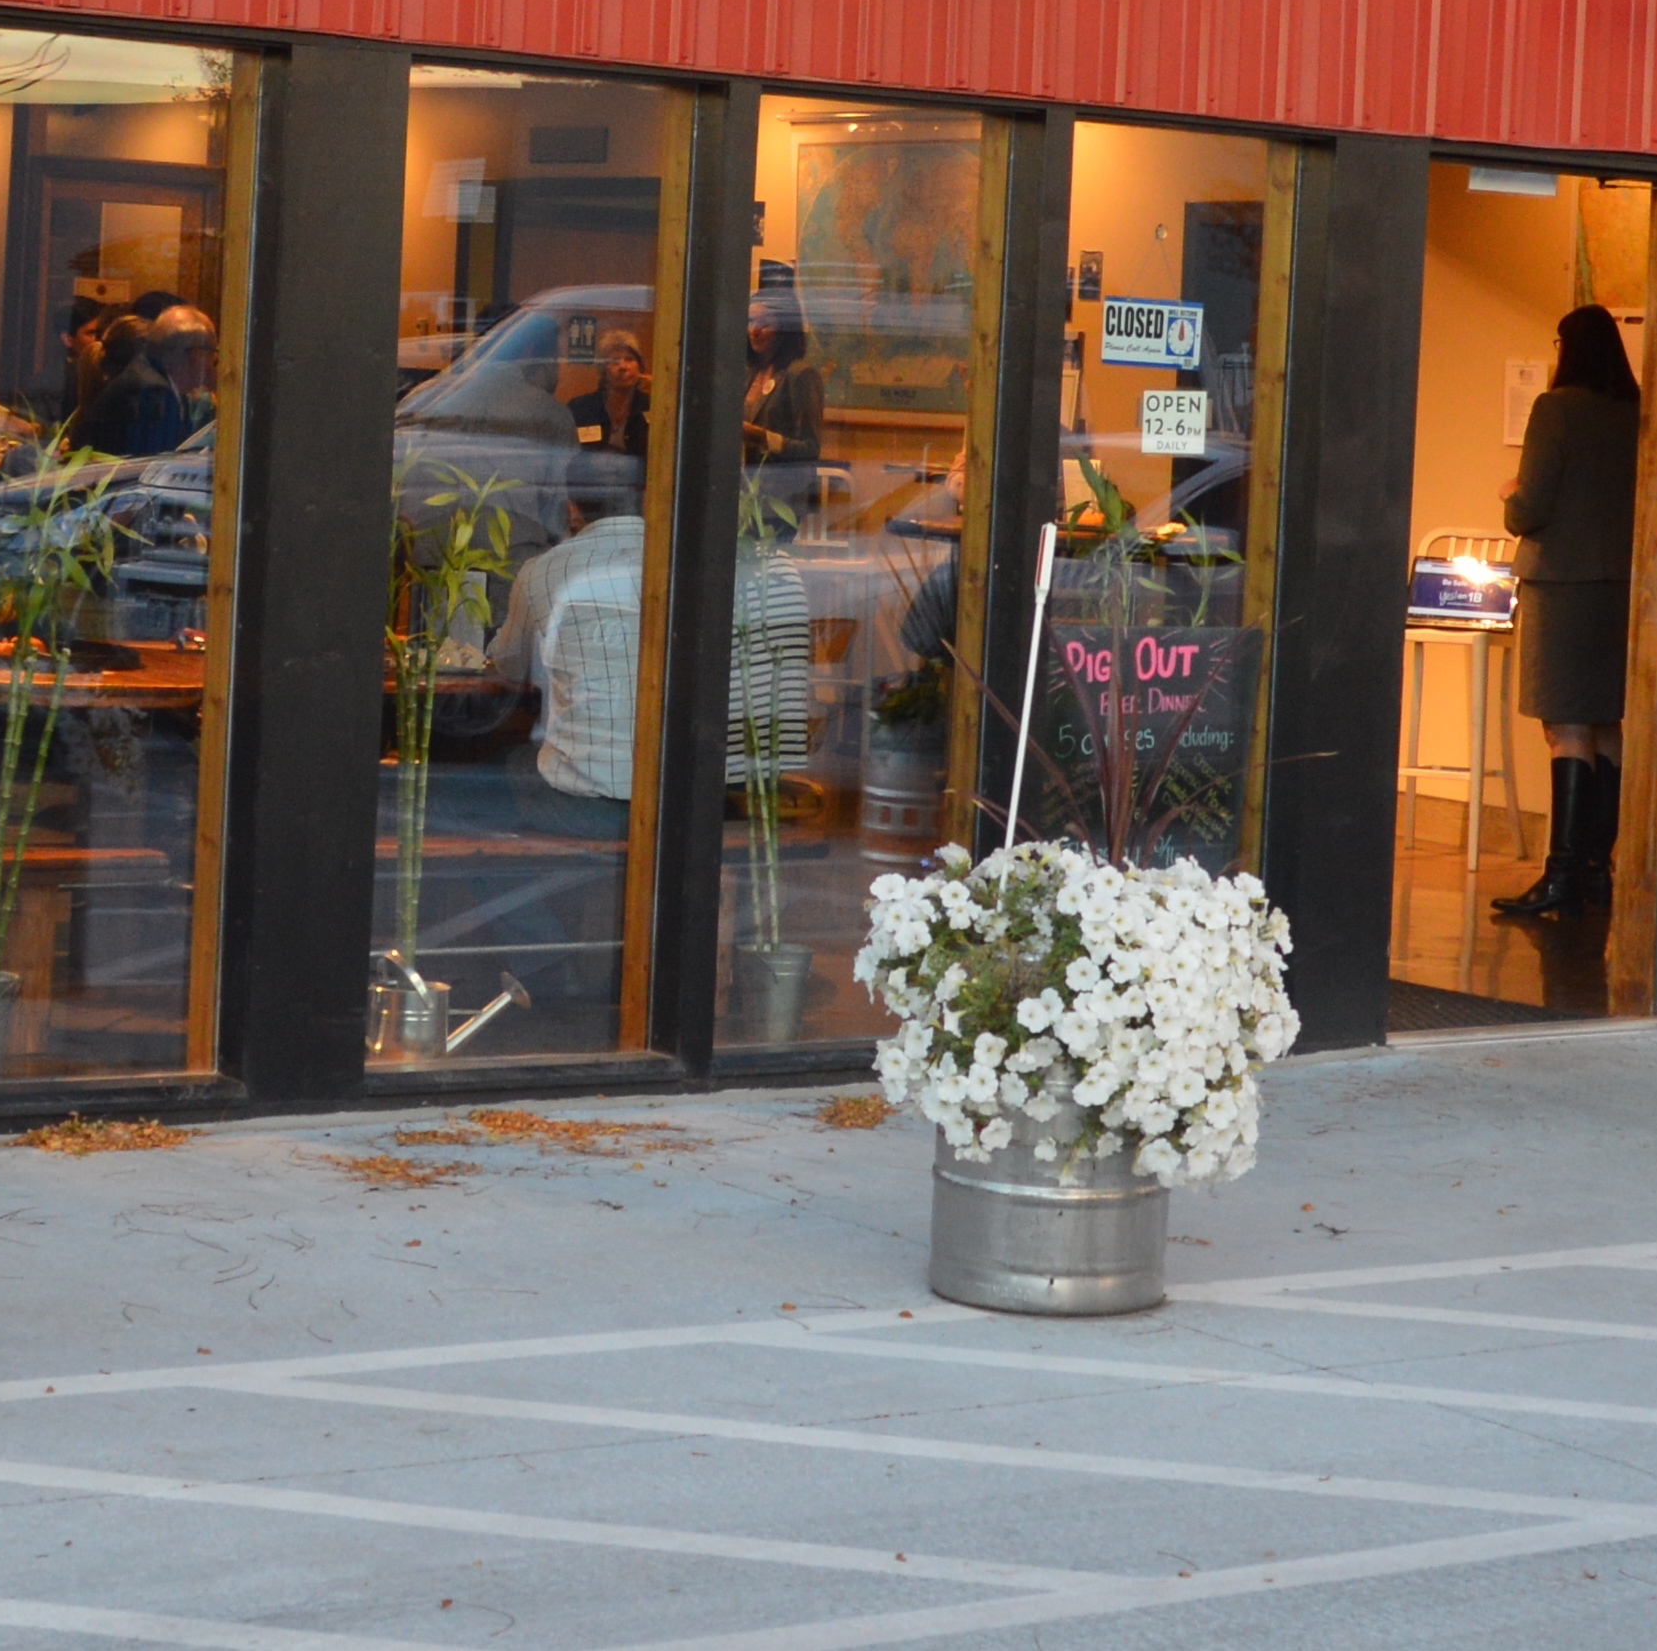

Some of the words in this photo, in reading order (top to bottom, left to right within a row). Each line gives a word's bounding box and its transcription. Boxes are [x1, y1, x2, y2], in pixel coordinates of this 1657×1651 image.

[1105, 305, 1164, 339] CLOSED
[1146, 395, 1201, 413] OPEN
[1156, 441, 1187, 450] DAILY
[1066, 640, 1112, 683] PIG
[1135, 636, 1199, 681] OUT
[1055, 724, 1076, 758] 5
